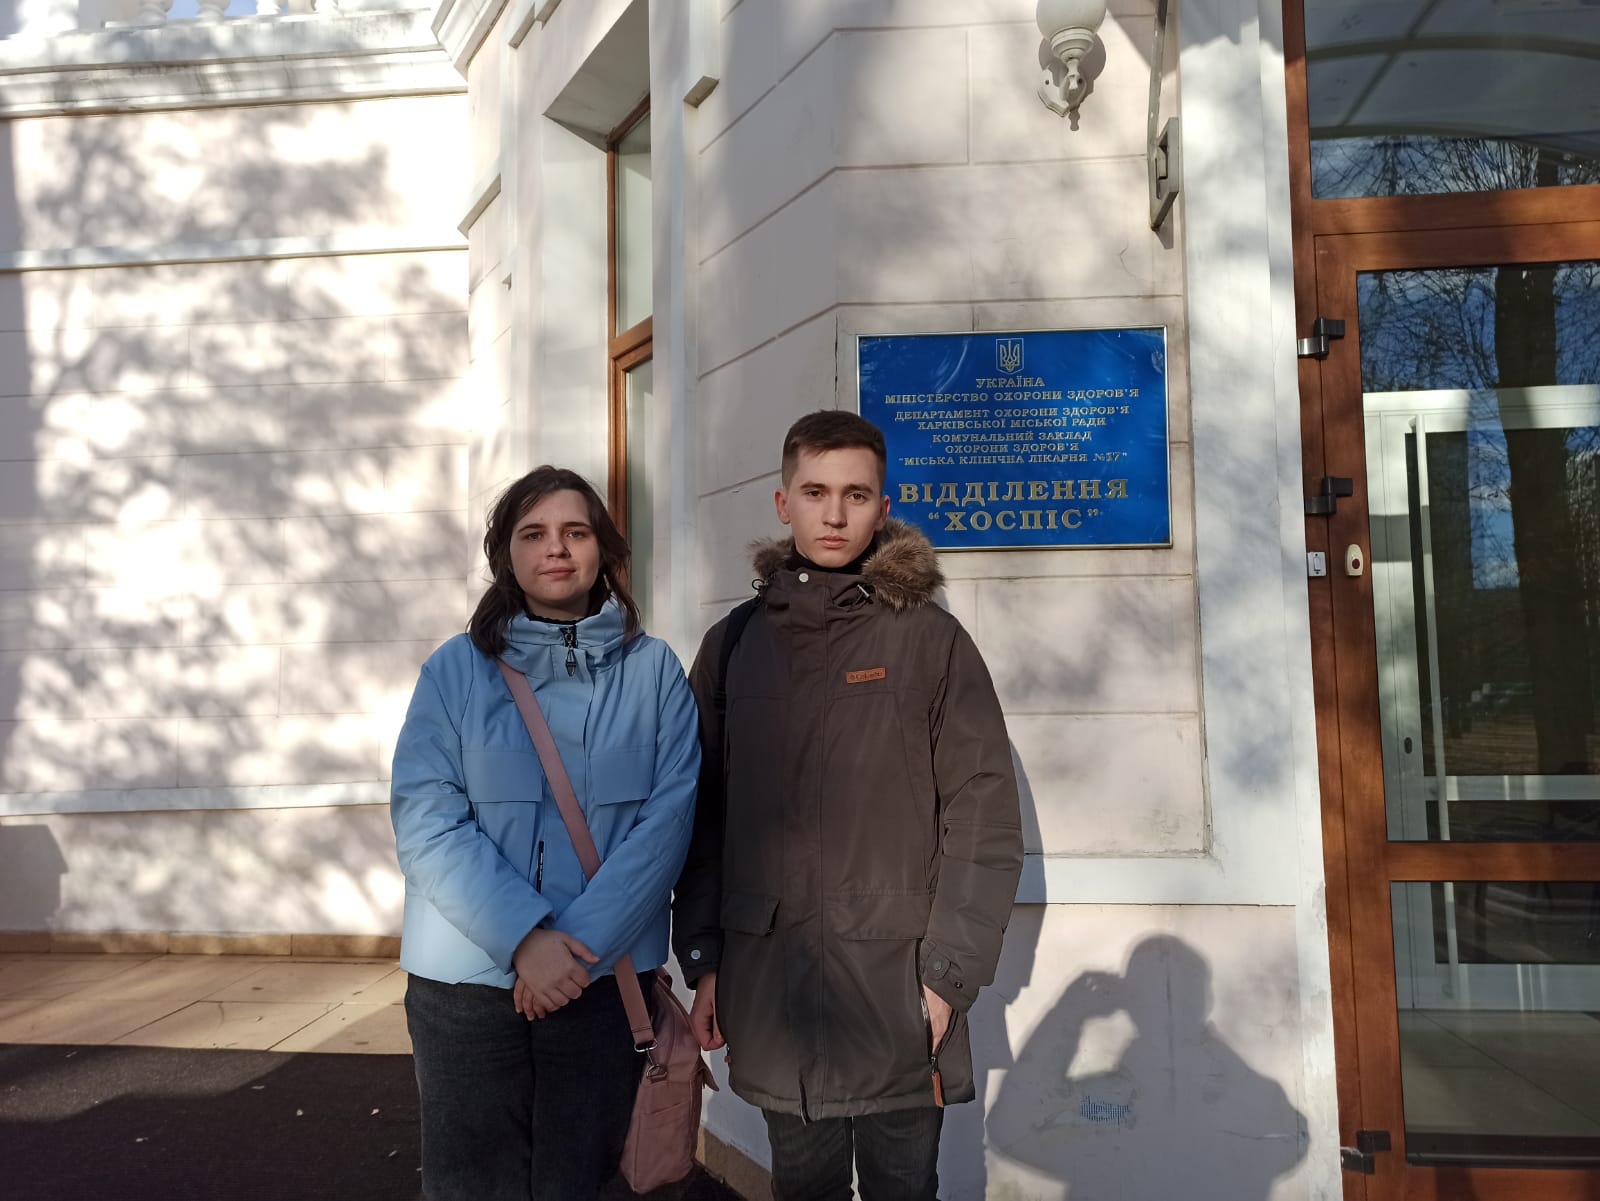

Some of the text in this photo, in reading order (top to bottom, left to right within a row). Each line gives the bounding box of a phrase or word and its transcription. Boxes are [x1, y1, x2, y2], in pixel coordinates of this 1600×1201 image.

[976, 376, 1045, 388] УКРАЇНА
[885, 392, 989, 404] МІНІСТЕРСТВО
[994, 391, 1062, 401] ОХОРОНИ
[895, 409, 989, 421] ДЕПАРТАМЕНТ
[994, 408, 1058, 417] ОХОРОНИ
[918, 417, 1106, 430] ХАРКІВСЬКОЇ МІСЬКОЇ РАДИ
[933, 431, 1091, 443] КОМУНАЛЬНИЙ ЗАКЛАД
[945, 444, 1008, 453] ОХОРОНИ
[959, 455, 1024, 464] КЛІНІЧНА
[1028, 453, 1087, 463] ЛІКАРНЯ
[898, 479, 1128, 507] ВІДДІЛЕННЯ
